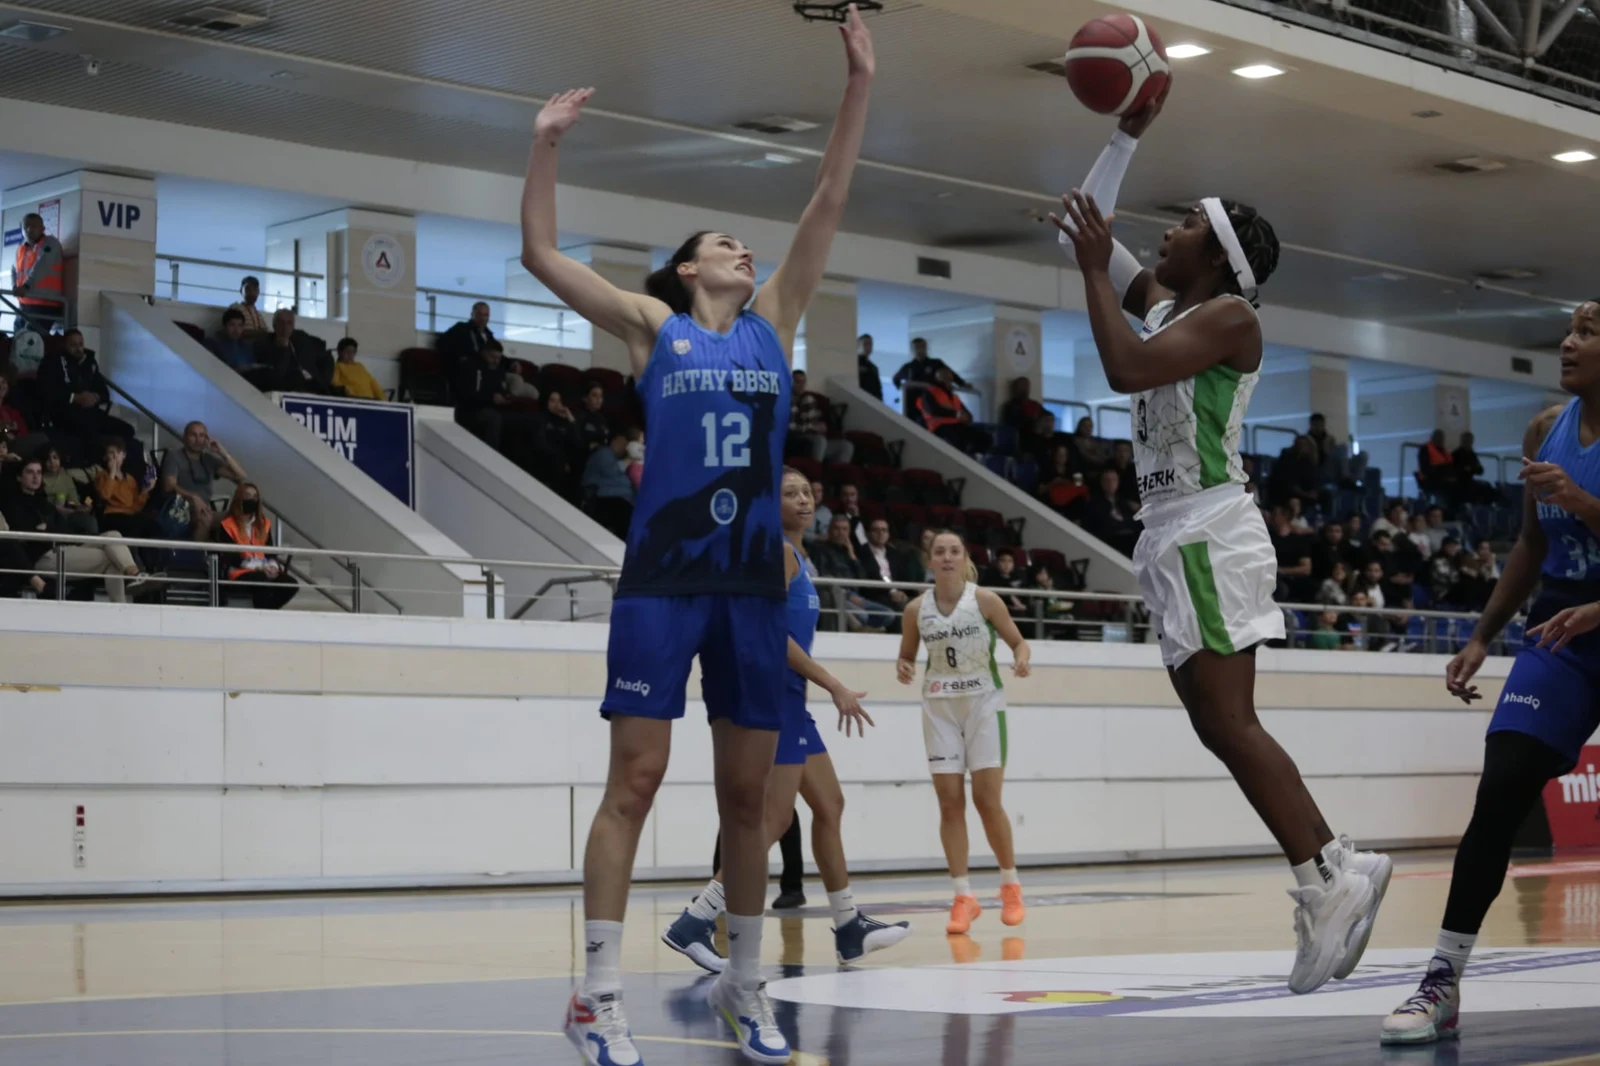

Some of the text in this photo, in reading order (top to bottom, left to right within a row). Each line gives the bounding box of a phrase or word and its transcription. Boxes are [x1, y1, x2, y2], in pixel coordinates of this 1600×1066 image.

[98, 200, 140, 229] VIP
[662, 369, 780, 398] HATAY BBSK
[701, 412, 751, 467] 12
[945, 646, 958, 668] 8
[615, 677, 651, 697] hado
[1510, 692, 1541, 710] hado
